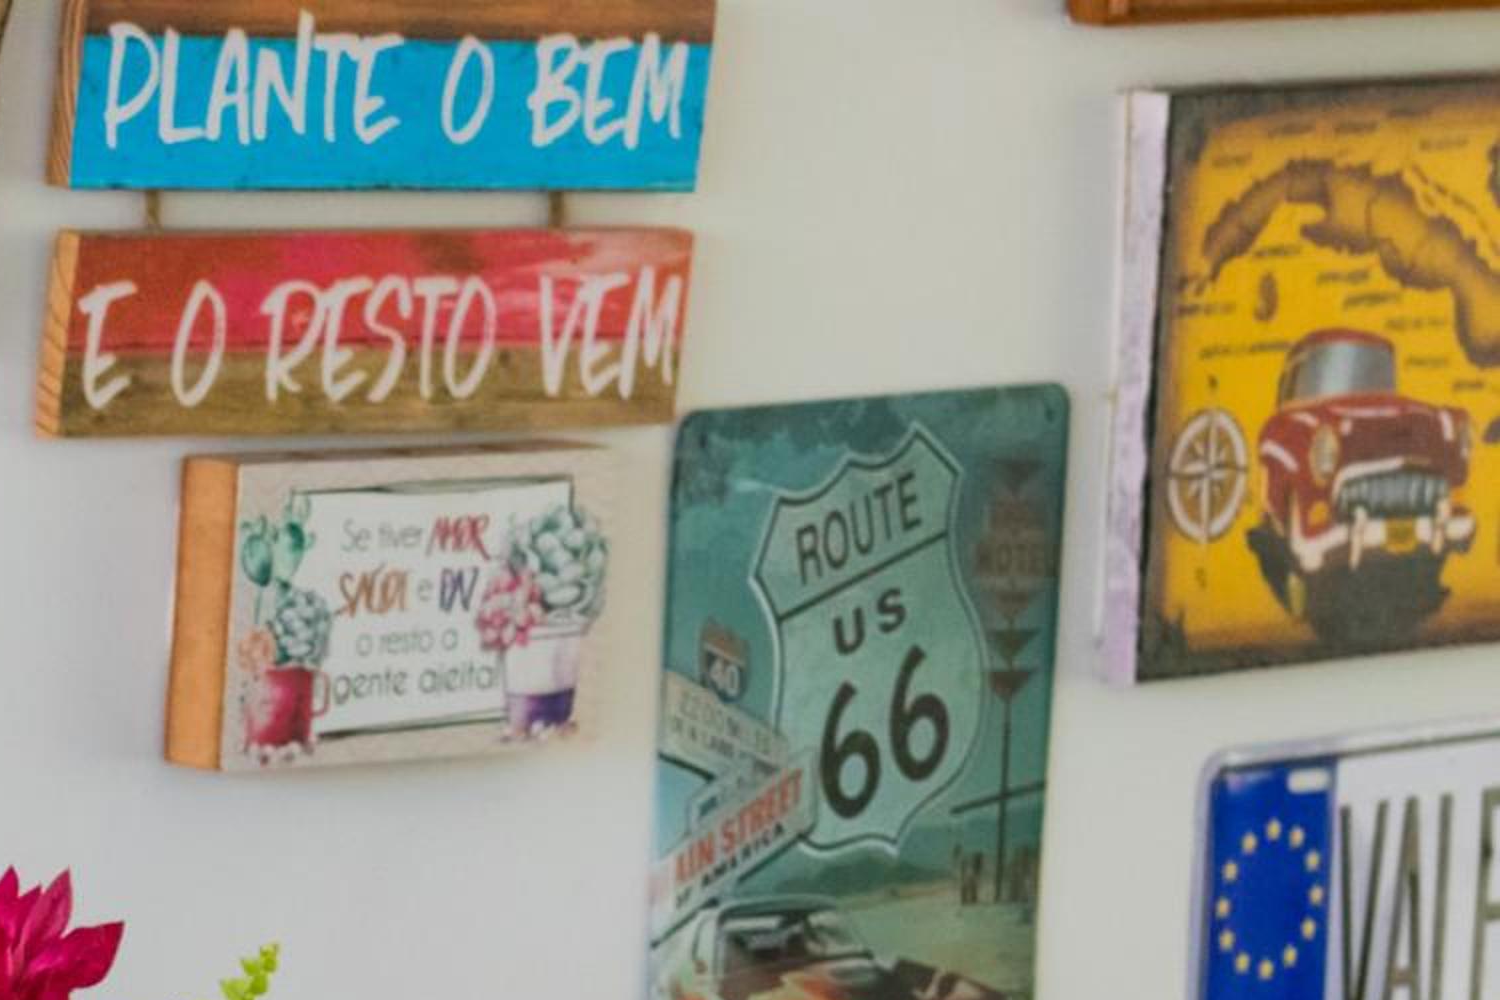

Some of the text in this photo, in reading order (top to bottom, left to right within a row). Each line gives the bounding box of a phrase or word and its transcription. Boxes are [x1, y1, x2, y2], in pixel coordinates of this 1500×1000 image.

[104, 11, 690, 149] PLANTE O BEM
[78, 264, 682, 410] E O RESTO VEM
[341, 518, 371, 551] Se
[796, 471, 923, 587] ROUTE
[833, 588, 908, 656] US
[819, 645, 950, 820] 66
